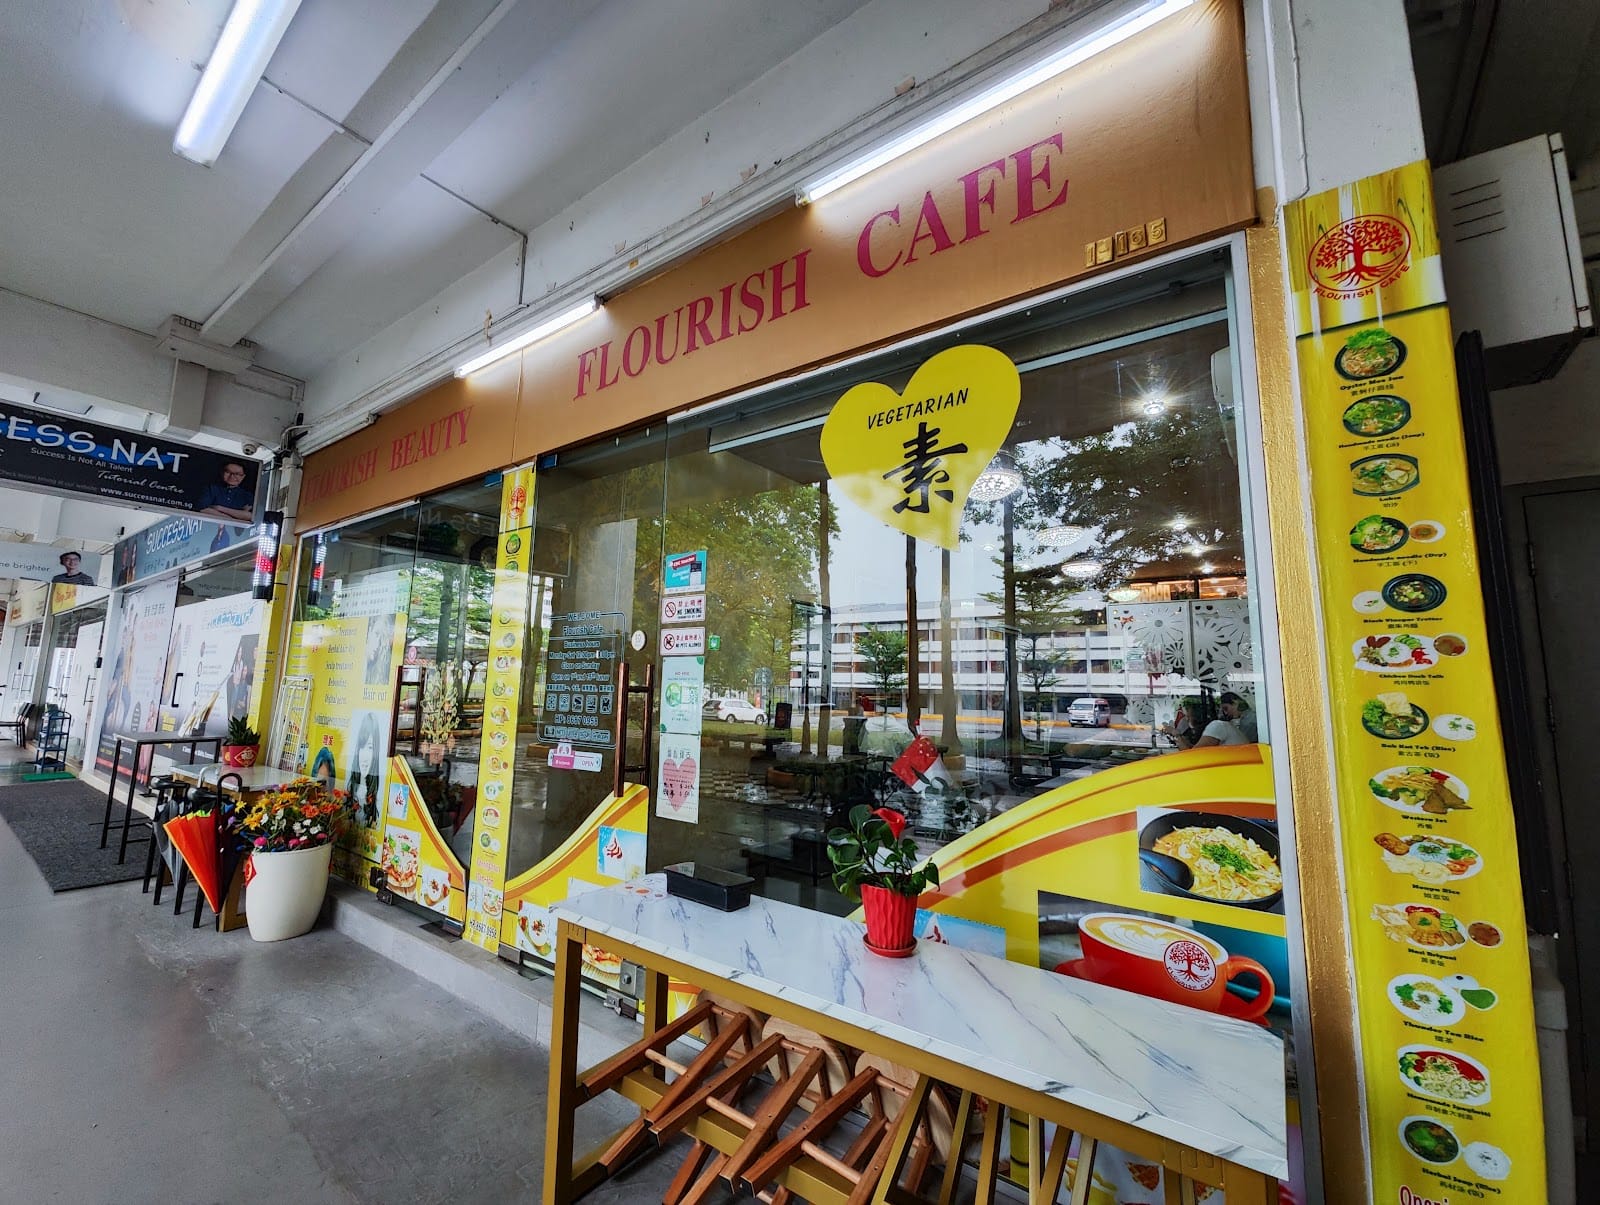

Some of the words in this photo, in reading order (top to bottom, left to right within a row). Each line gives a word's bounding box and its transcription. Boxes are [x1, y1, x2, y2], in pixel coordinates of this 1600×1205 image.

[572, 250, 811, 400] FLOURISH
[857, 132, 1070, 278] CAFE
[1313, 286, 1374, 300] FLOURISH
[1379, 264, 1410, 289] CAFE
[867, 387, 969, 430] VEGETARIAN
[0, 413, 190, 474] ESS.NAT
[389, 405, 474, 472] BEAUTY
[31, 447, 65, 460] Success
[68, 454, 76, 462] Is
[78, 456, 93, 465] Not
[95, 459, 107, 468] All
[109, 462, 133, 473] Talent
[98, 470, 147, 486] Tutorial
[882, 422, 969, 514] 素
[100, 486, 193, 509] www.successnat.com.sg
[146, 517, 203, 554] SUCCESS.NAT
[13, 562, 50, 572] brighter
[1167, 966, 1198, 990] FLOURISH
[1200, 976, 1213, 989] CAFE
